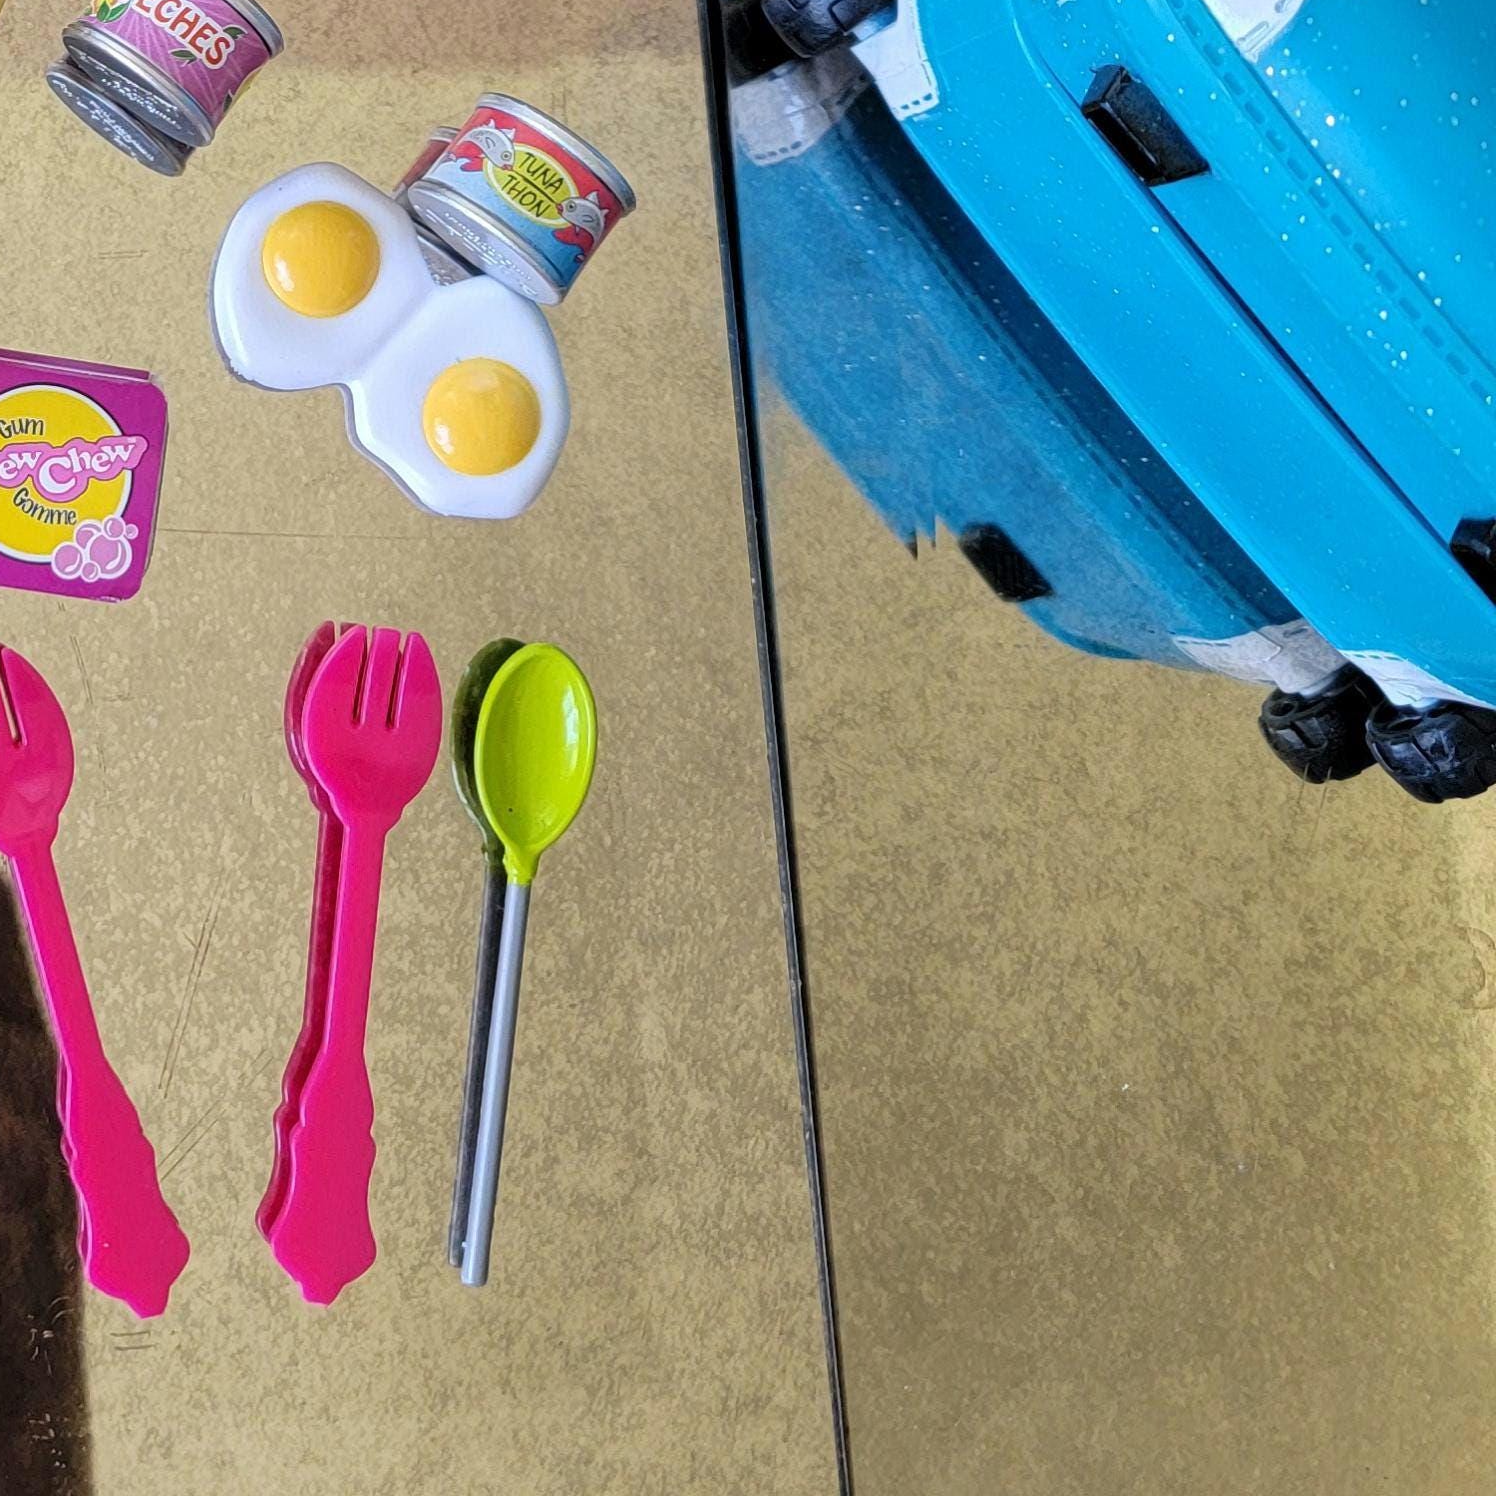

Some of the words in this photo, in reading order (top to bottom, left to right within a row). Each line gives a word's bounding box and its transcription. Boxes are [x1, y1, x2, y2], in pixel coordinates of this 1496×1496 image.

[518, 151, 564, 194] TUNA
[501, 174, 551, 218] THON
[38, 443, 135, 494] Chew
[12, 487, 77, 525] Gomme
